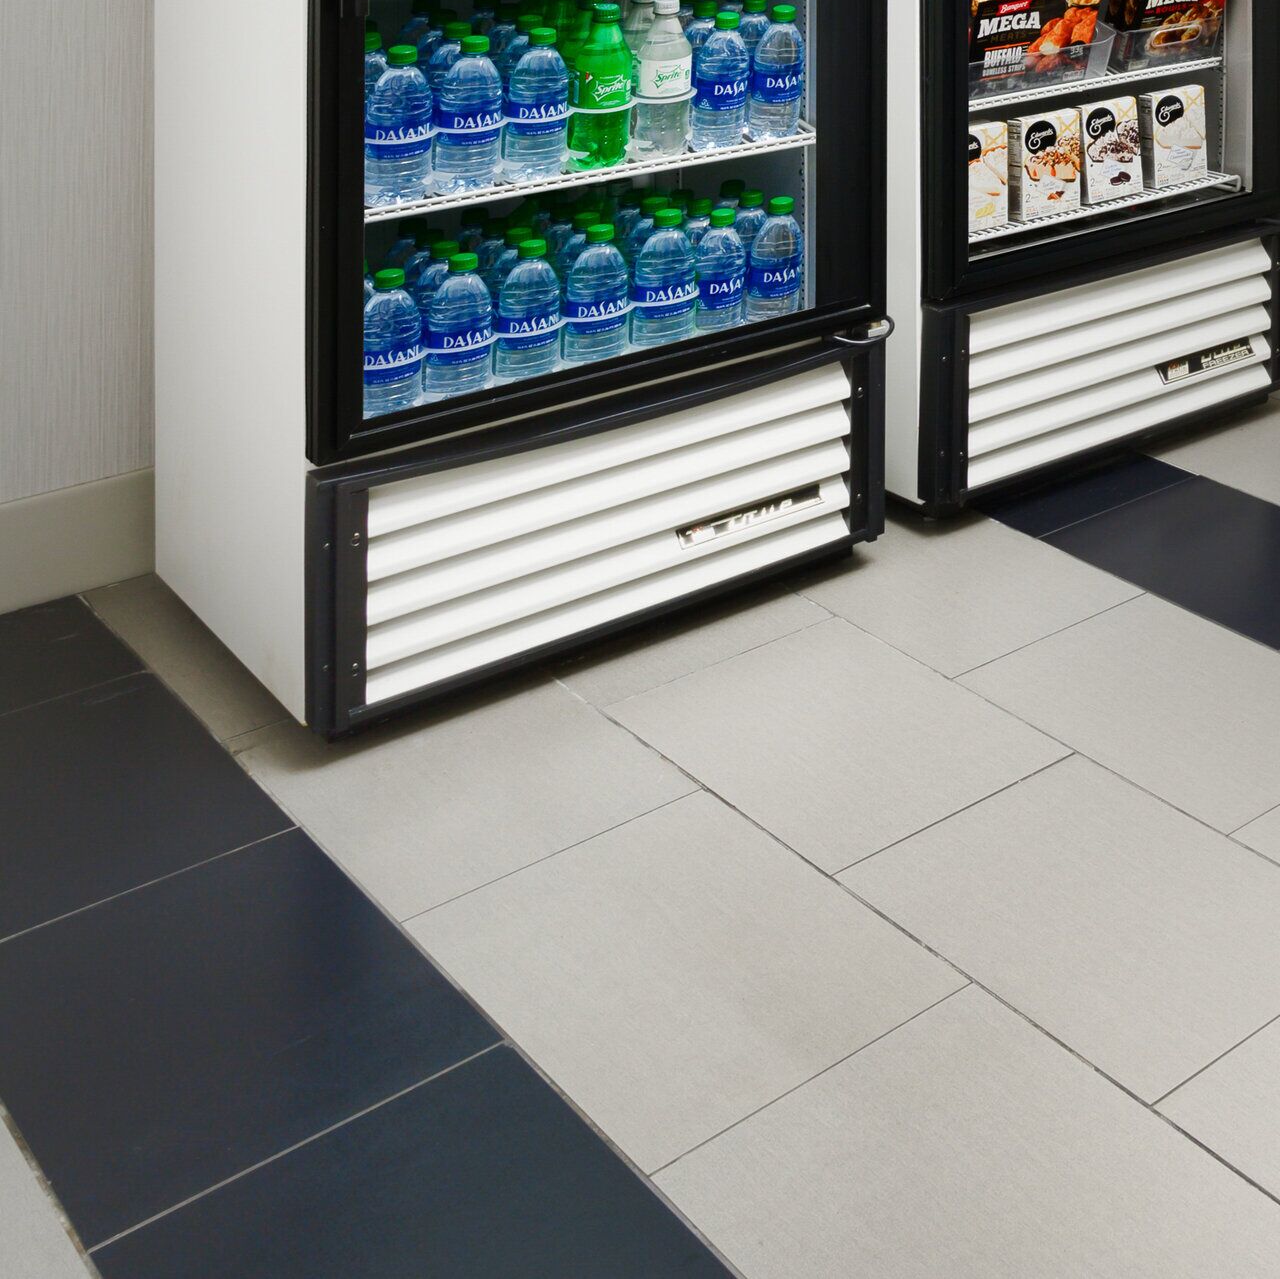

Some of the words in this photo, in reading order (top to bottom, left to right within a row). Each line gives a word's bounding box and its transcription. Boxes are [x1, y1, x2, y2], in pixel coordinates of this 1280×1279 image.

[1000, 0, 1029, 13] Banquet
[977, 11, 1041, 39] MEGA
[656, 71, 681, 82] Sprite
[596, 82, 625, 95] Sprite
[1158, 163, 1163, 172] 2
[1025, 194, 1032, 203] 2
[1202, 350, 1249, 369] FREEZER
